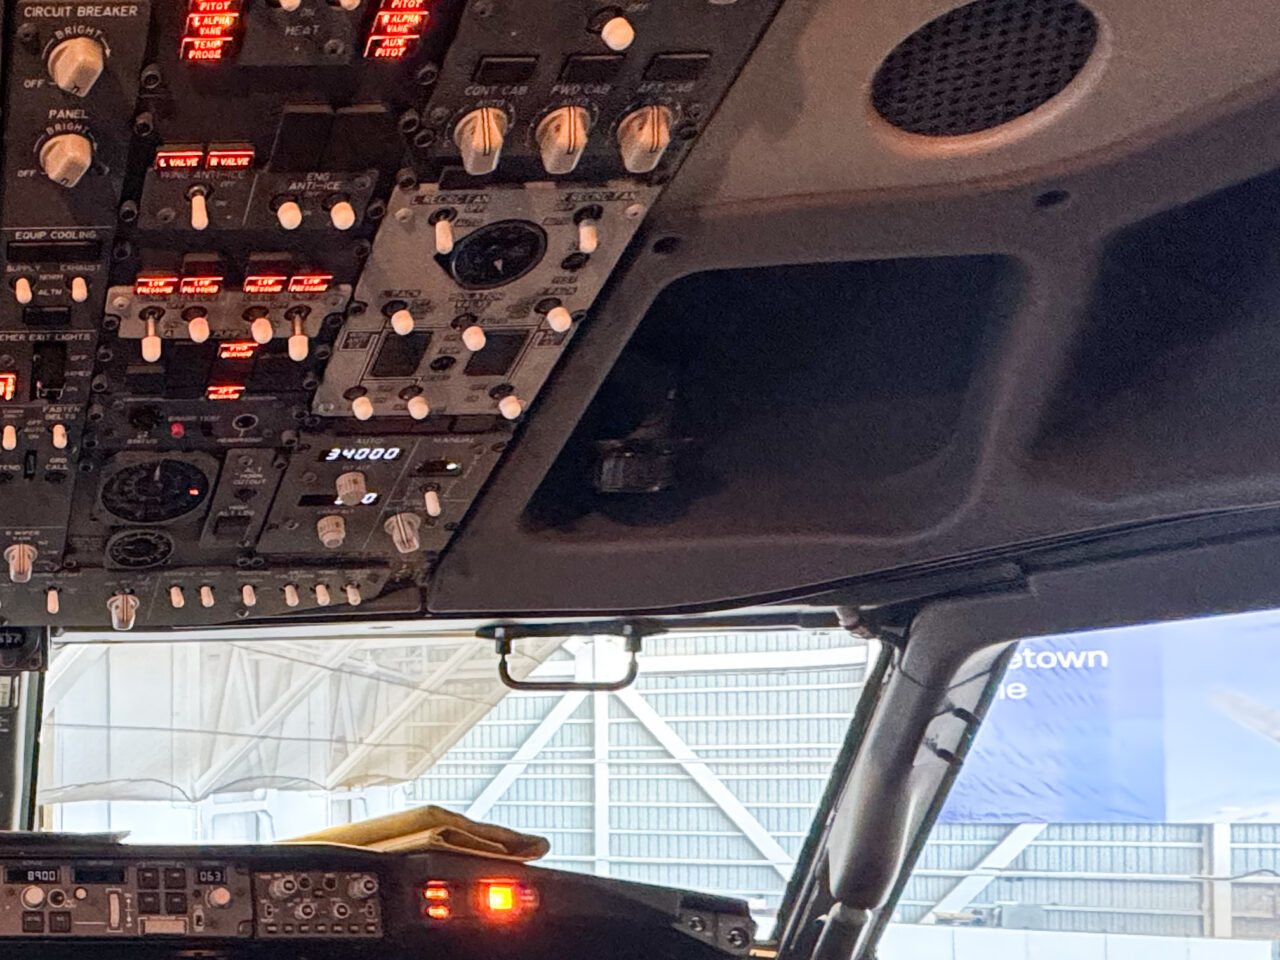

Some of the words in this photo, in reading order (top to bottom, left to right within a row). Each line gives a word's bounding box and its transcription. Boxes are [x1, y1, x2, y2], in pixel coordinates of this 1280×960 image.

[199, 1, 231, 11] PITOT
[391, 0, 423, 9] PITOT
[23, 6, 71, 17] CIRCUIT
[77, 5, 138, 17] BREAKER
[202, 16, 231, 25] ALPHA
[391, 14, 419, 23] ALPHA
[55, 25, 102, 40] BRIGHT
[199, 27, 222, 36] VANE
[285, 25, 320, 36] HEAT
[387, 24, 409, 33] VANE
[193, 40, 221, 49] TEMP
[382, 38, 405, 47] AUX
[188, 50, 222, 59] PROBE
[375, 47, 407, 57] PITOT
[23, 79, 45, 88] OFF
[465, 86, 500, 96] CONT
[502, 85, 528, 96] CAB
[550, 85, 581, 95] FWD
[584, 84, 610, 95] CAB
[48, 109, 89, 119] PANEL
[46, 123, 89, 135] BRIGHT
[170, 158, 199, 167] VALVE
[221, 157, 251, 166] VALVE
[17, 169, 38, 178] OFF
[307, 172, 330, 181] ENG
[289, 181, 342, 191] ANTI-ICE
[15, 231, 47, 240] EQUIP
[50, 230, 97, 239] COOLING
[59, 264, 102, 272] EXHAUST
[55, 333, 91, 341] LIGHTS
[326, 448, 399, 460] 34000
[27, 870, 56, 881] 8900
